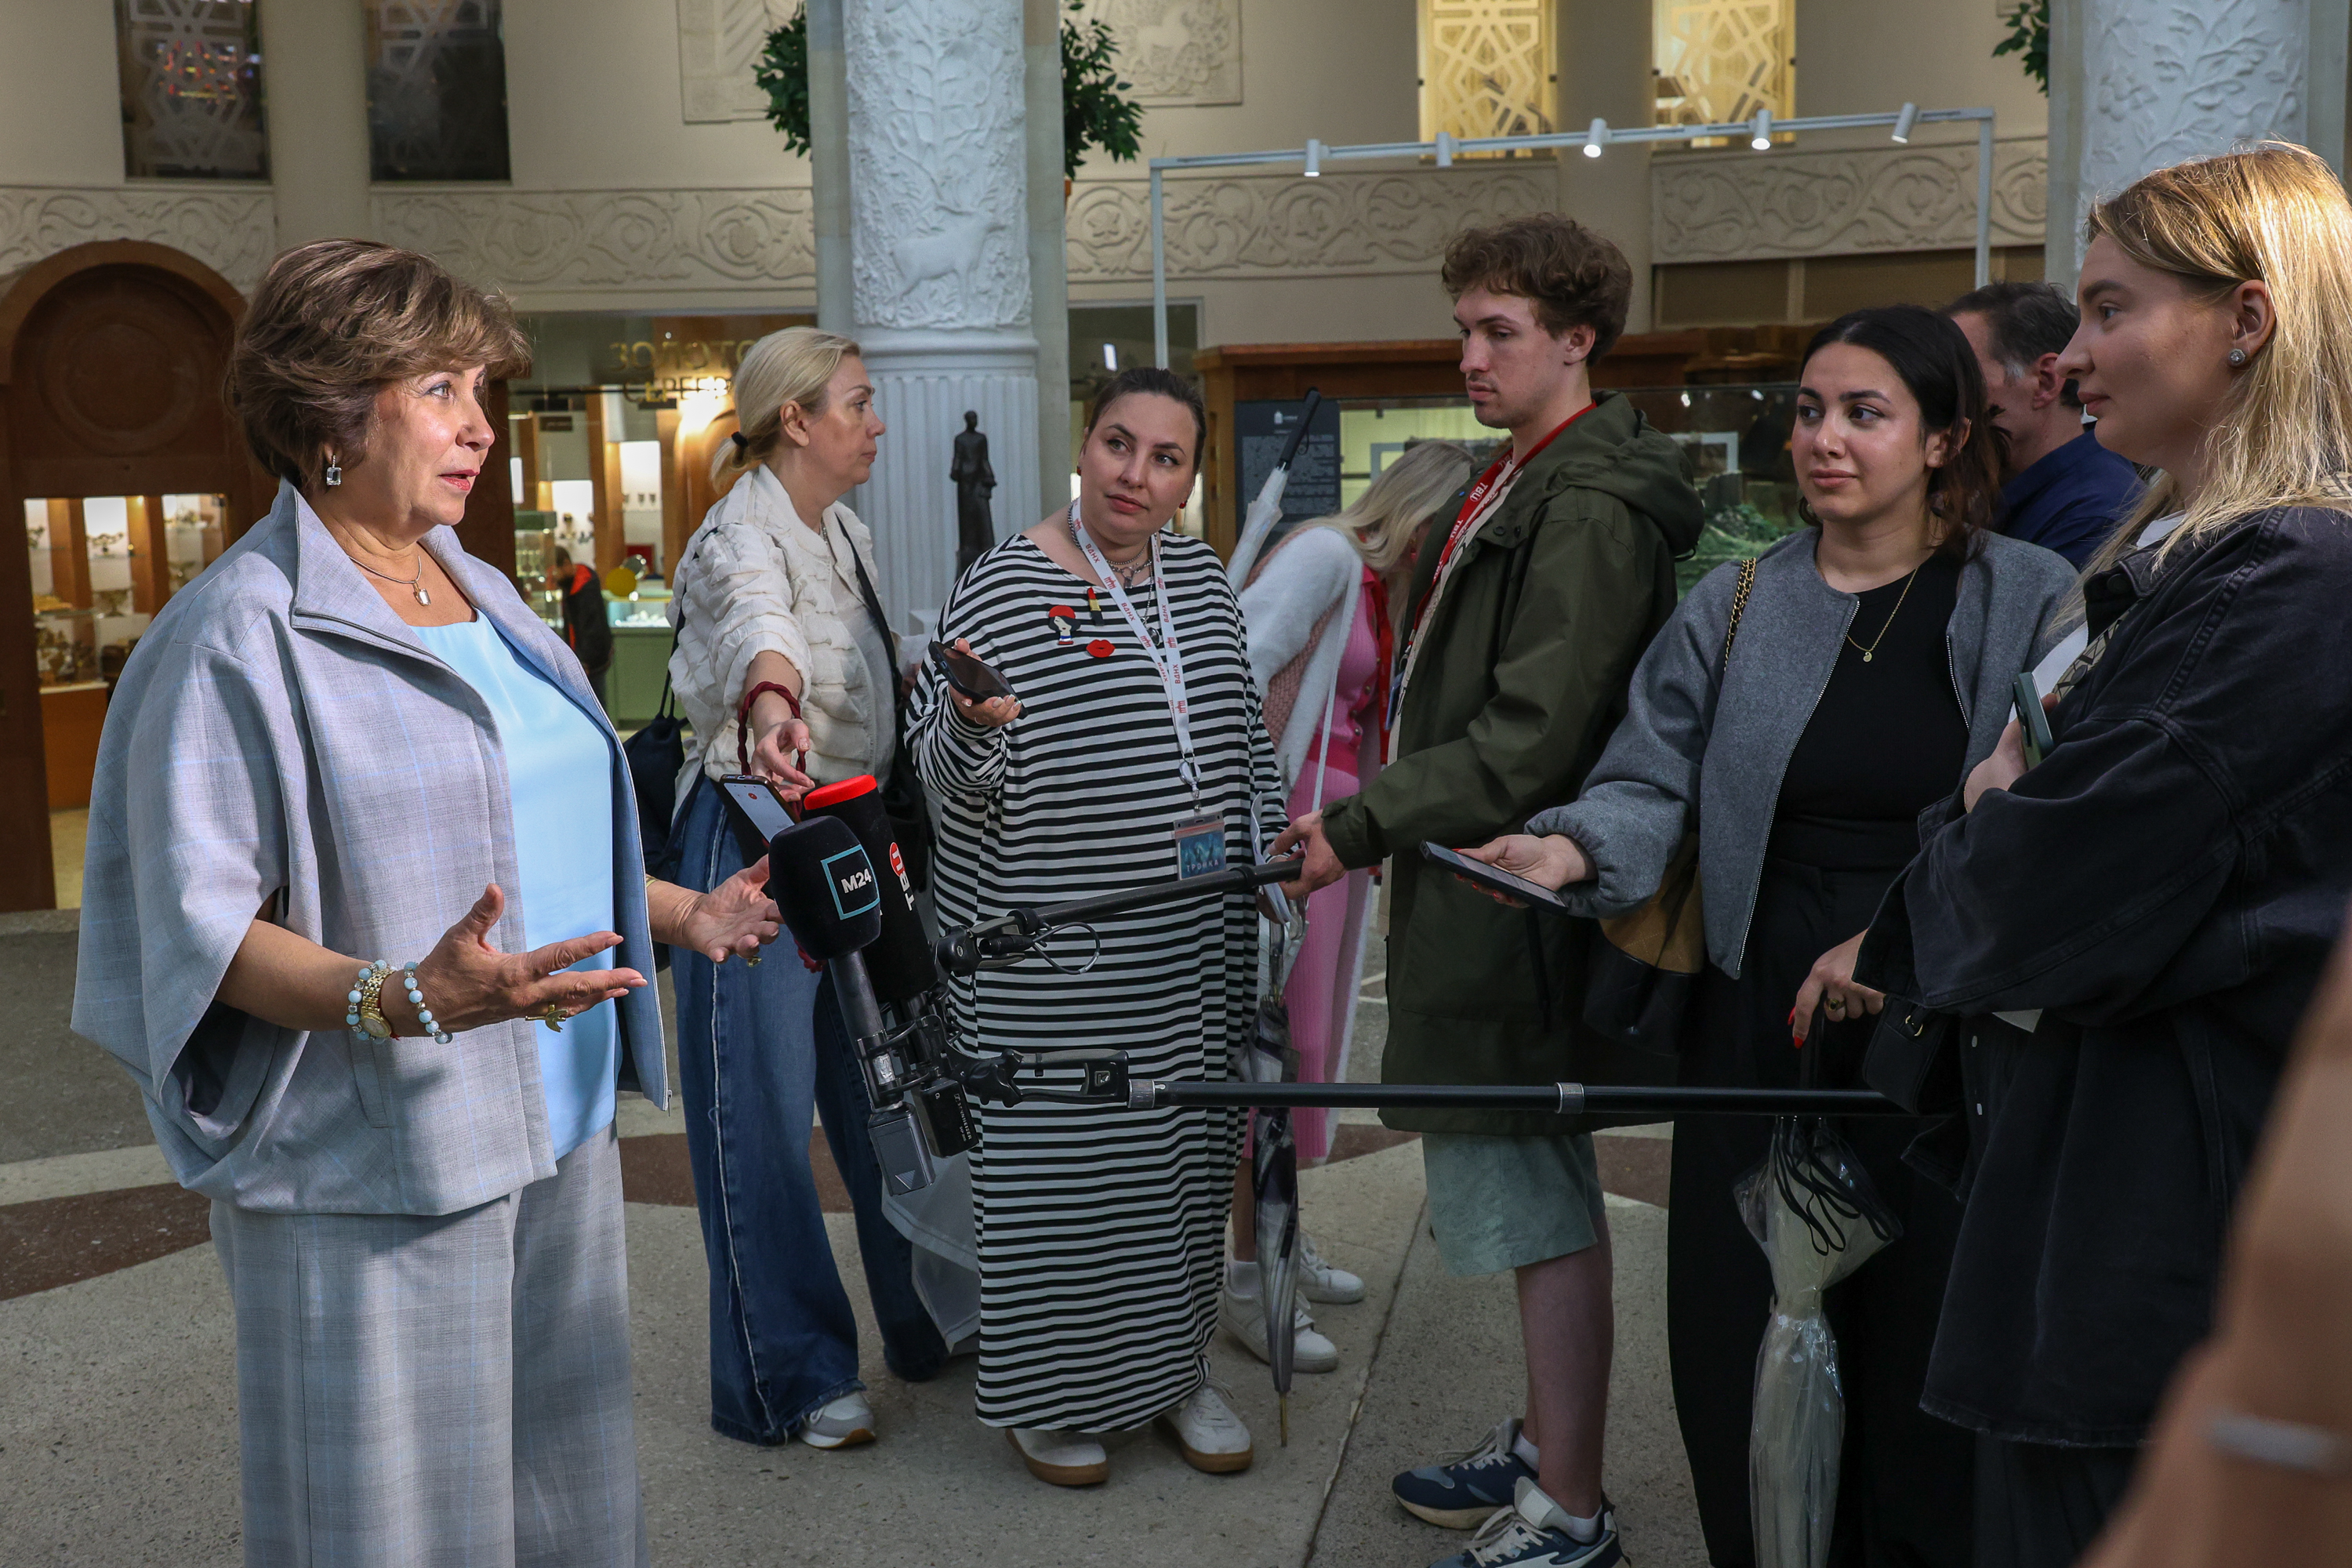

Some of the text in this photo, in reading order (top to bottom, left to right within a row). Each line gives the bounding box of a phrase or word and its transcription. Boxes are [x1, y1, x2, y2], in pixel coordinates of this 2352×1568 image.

[1085, 543, 1101, 563] ВДНХ
[1121, 602, 1136, 622] ВДНХ
[1161, 604, 1170, 623] ВДНХ
[1172, 664, 1181, 684] ВДНХ
